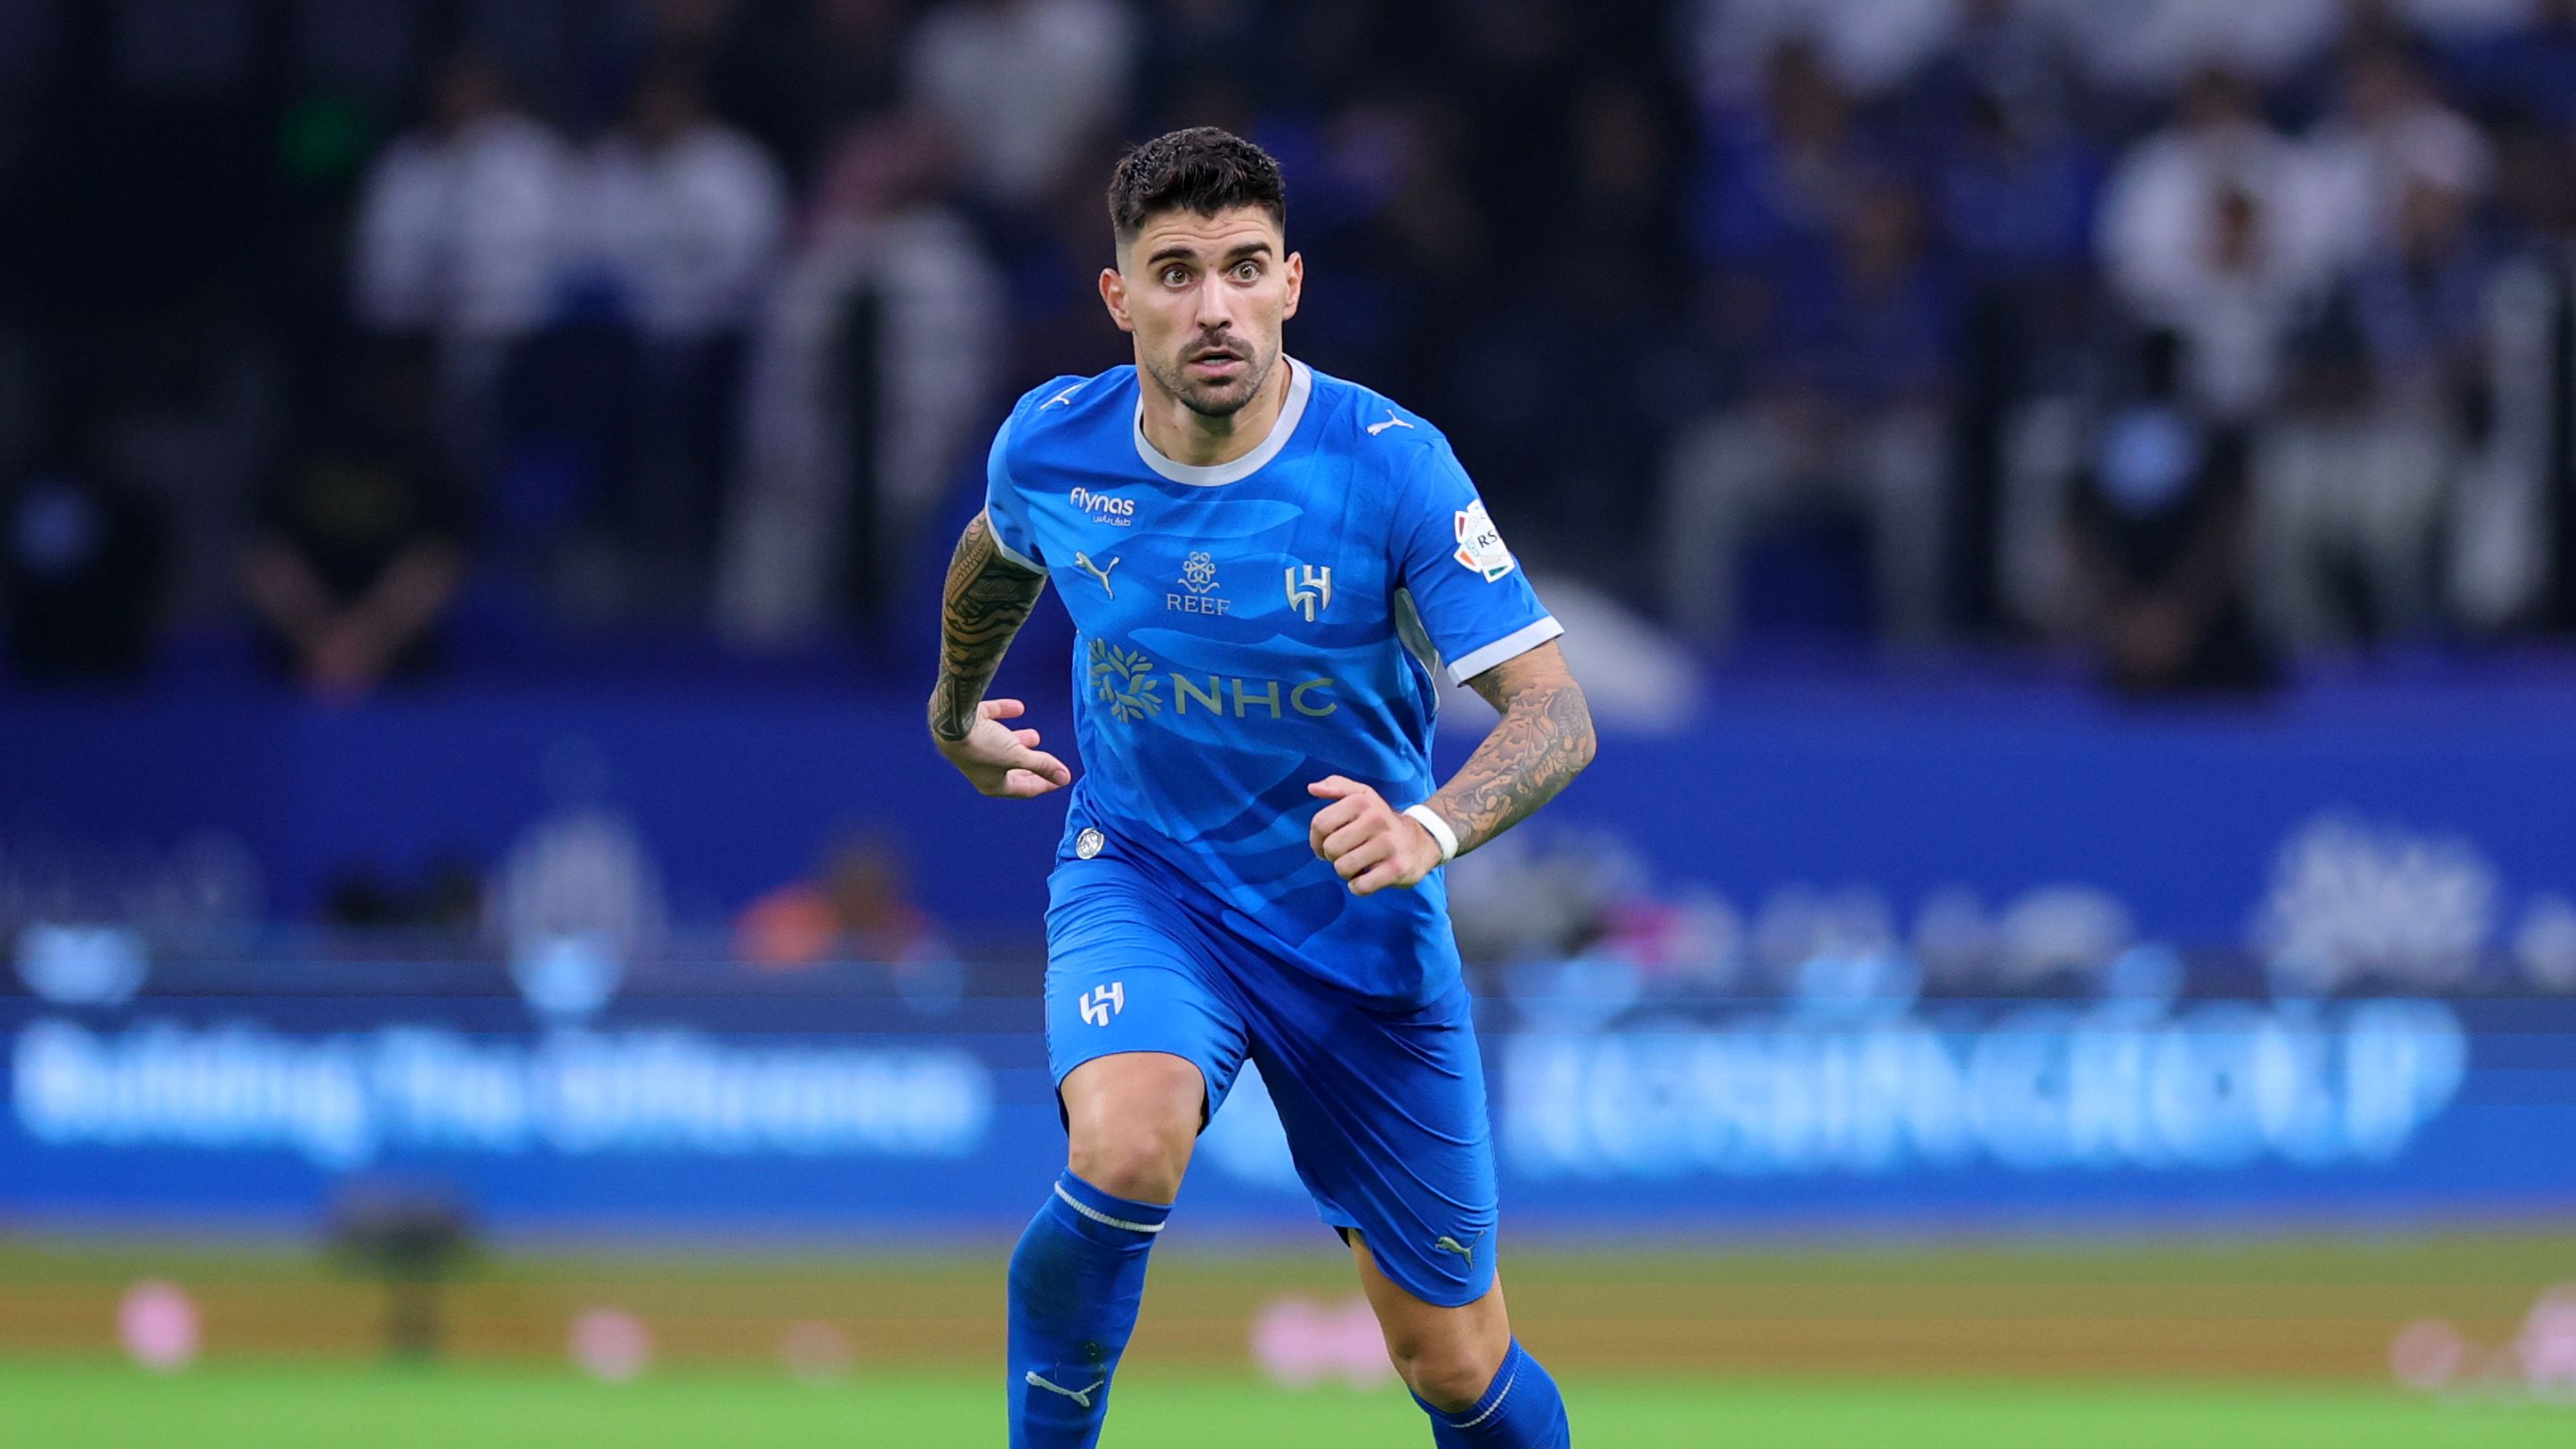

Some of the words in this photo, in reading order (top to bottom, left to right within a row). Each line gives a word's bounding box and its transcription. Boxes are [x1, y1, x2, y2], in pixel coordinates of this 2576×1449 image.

[1070, 487, 1135, 516] flynas
[1167, 593, 1231, 616] REEF
[1169, 672, 1337, 719] NHC
